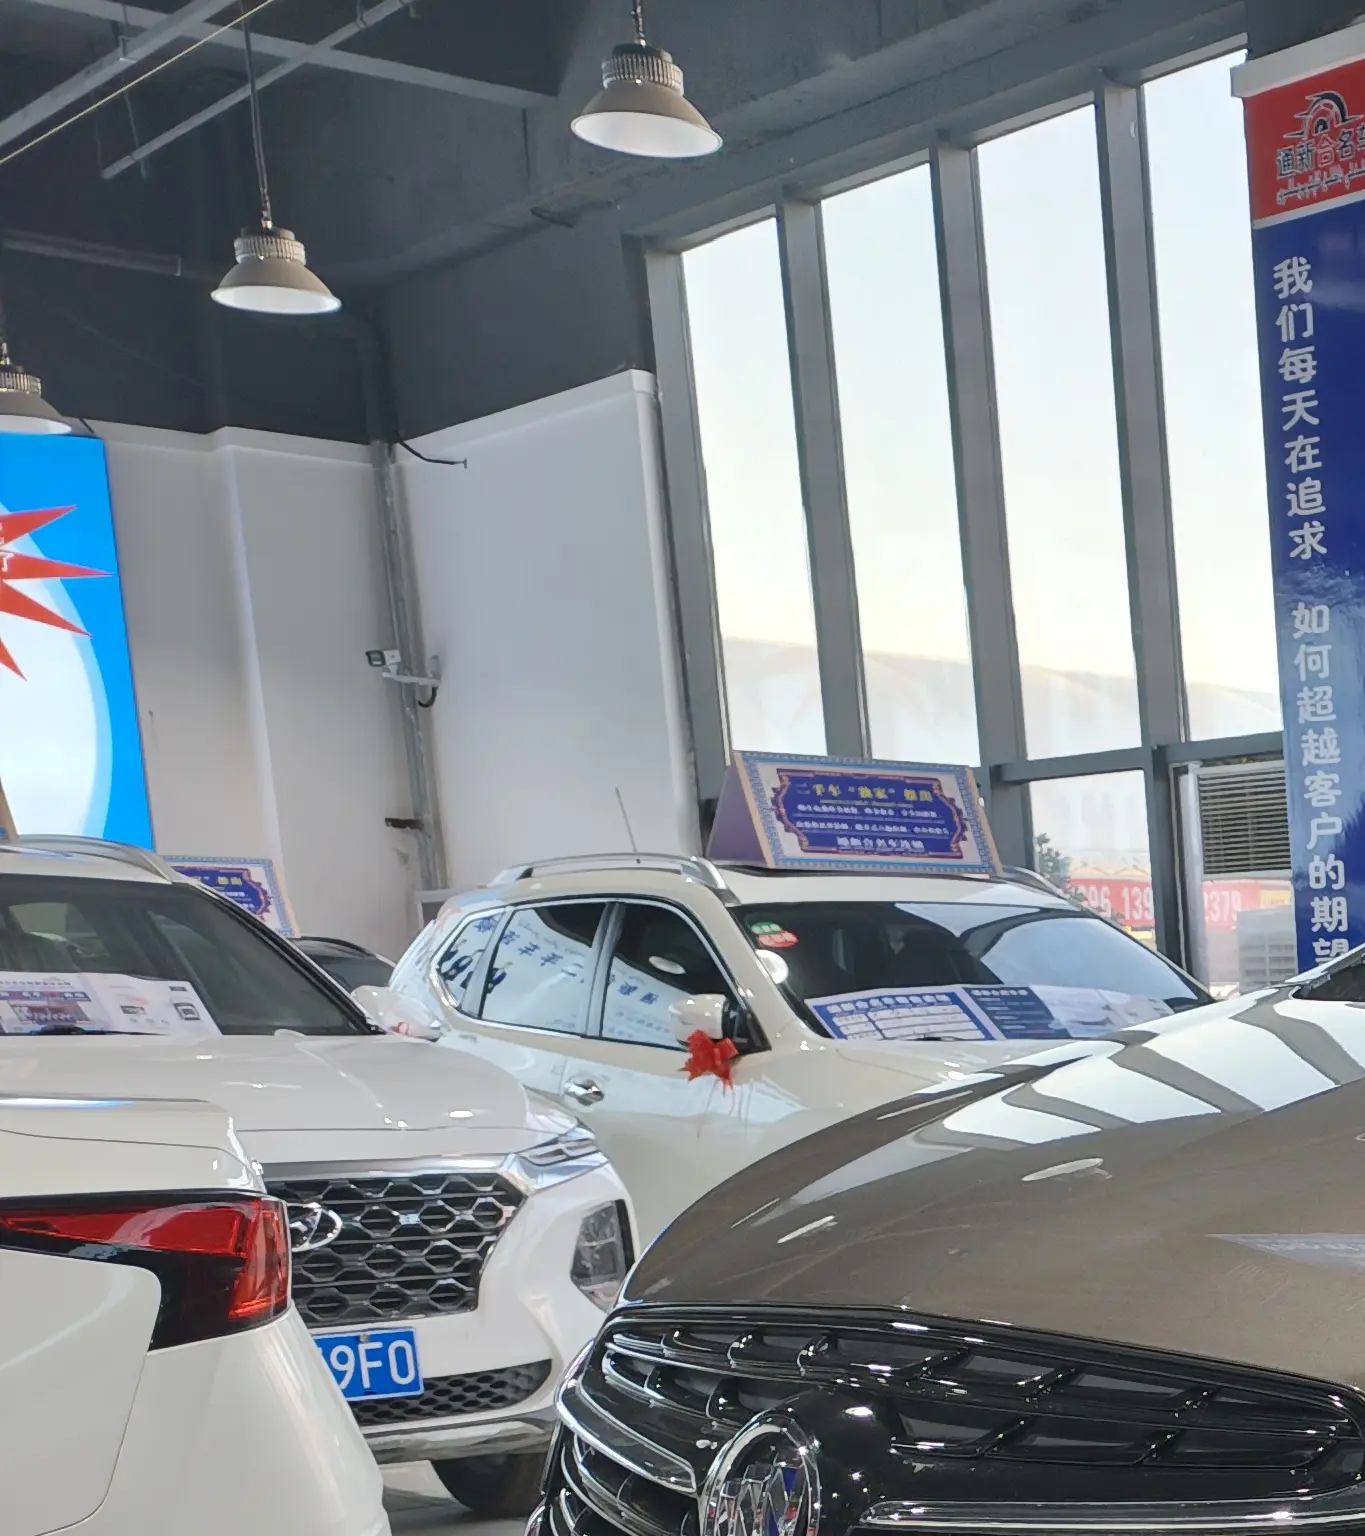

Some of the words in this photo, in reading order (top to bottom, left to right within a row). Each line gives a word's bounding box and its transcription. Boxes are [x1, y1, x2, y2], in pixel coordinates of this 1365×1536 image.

[1273, 256, 1328, 560] 我们每天在追求
[319, 1339, 416, 1390] 9F0
